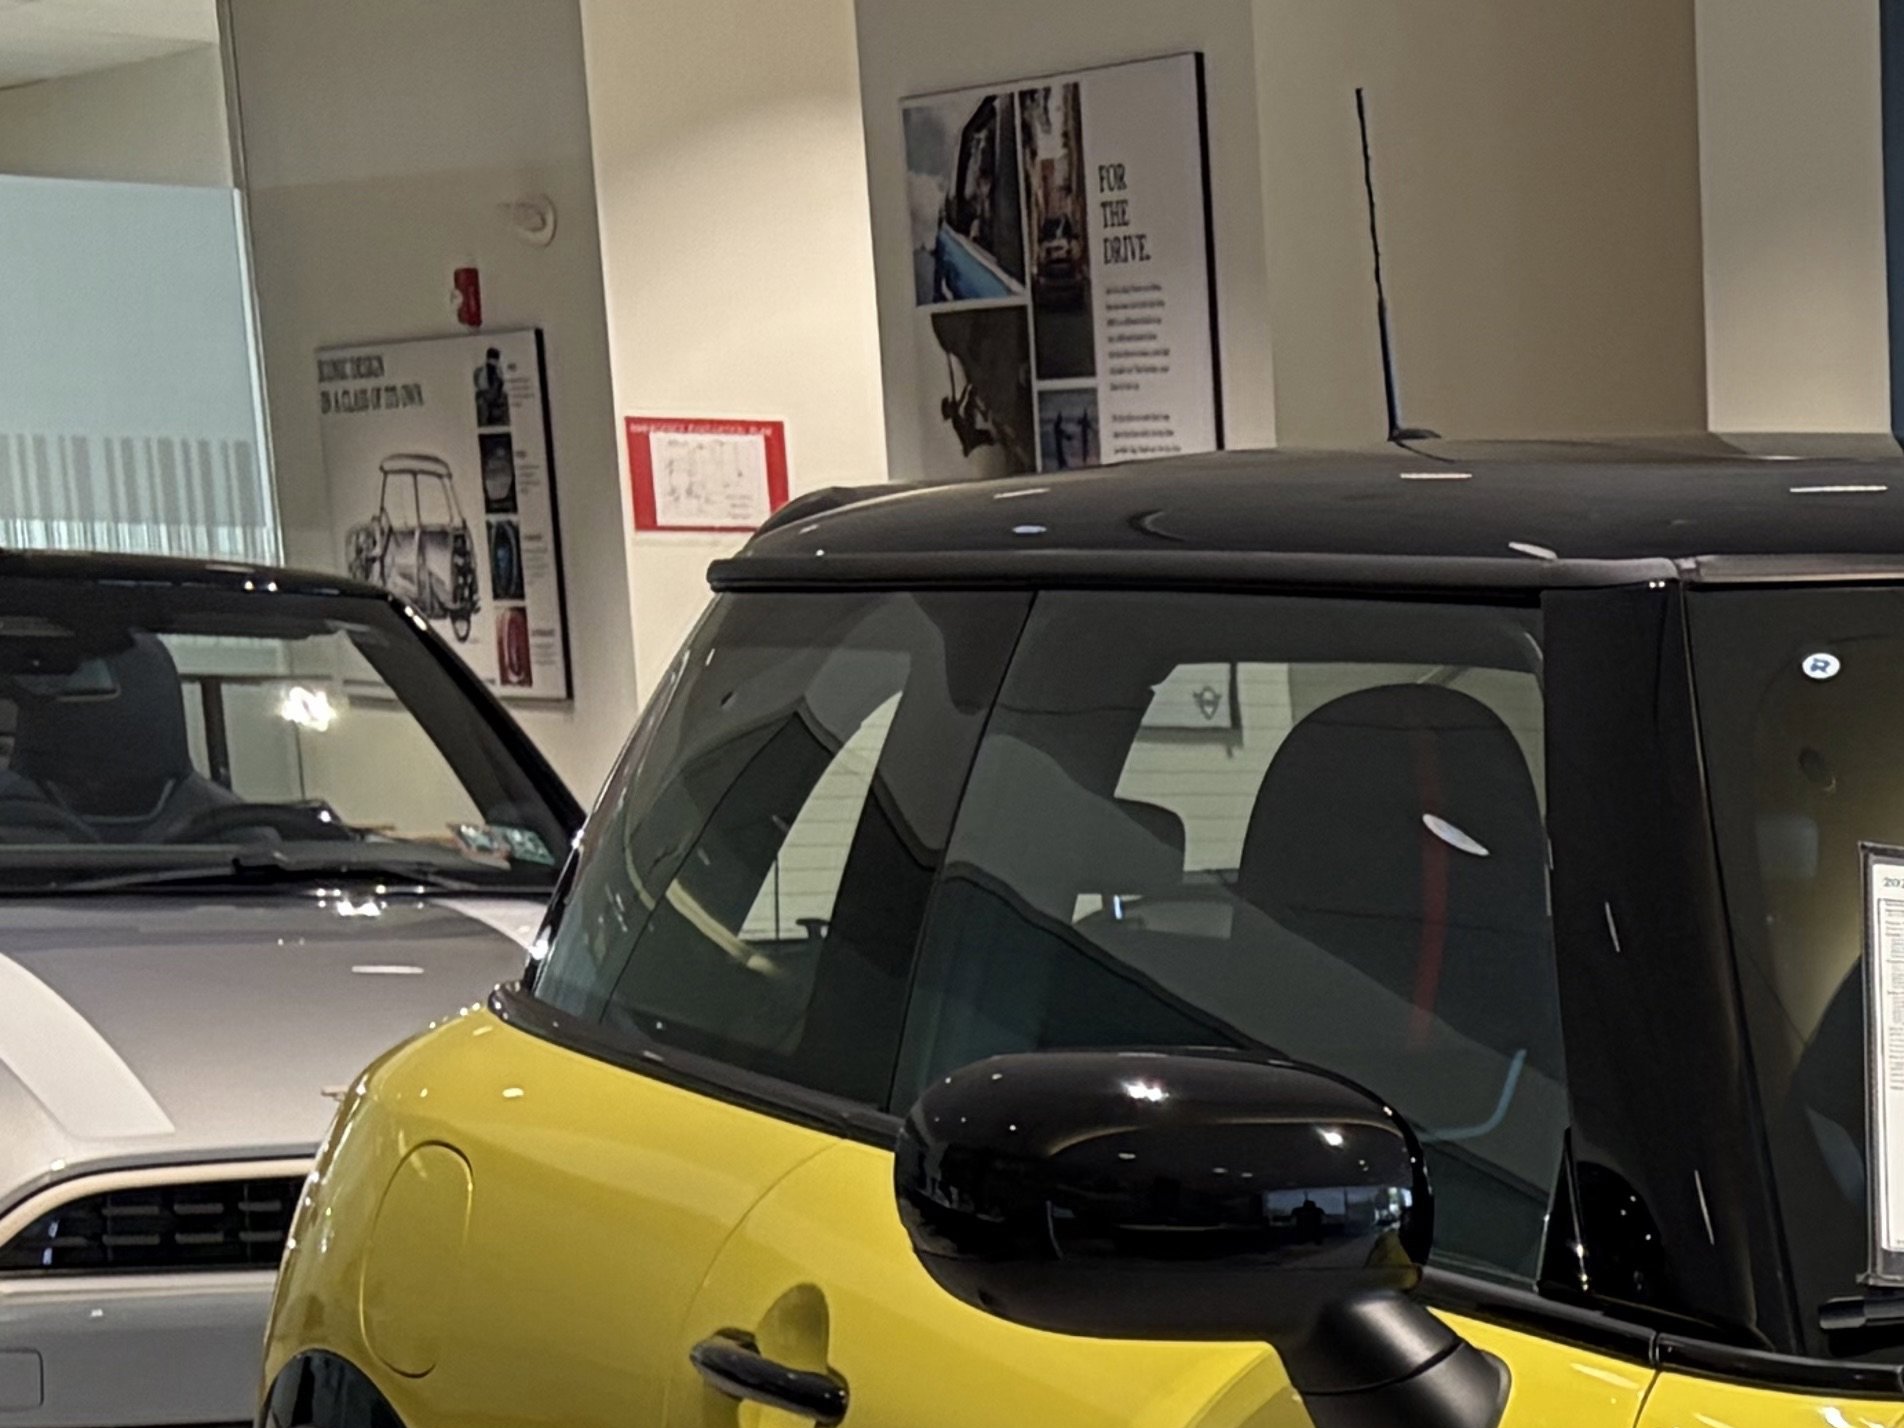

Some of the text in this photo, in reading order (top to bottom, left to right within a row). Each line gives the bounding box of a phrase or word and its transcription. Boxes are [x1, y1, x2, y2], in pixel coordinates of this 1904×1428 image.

[1098, 163, 1127, 193] FOR
[1101, 199, 1130, 228] THE
[1103, 234, 1152, 265] DRIVE.
